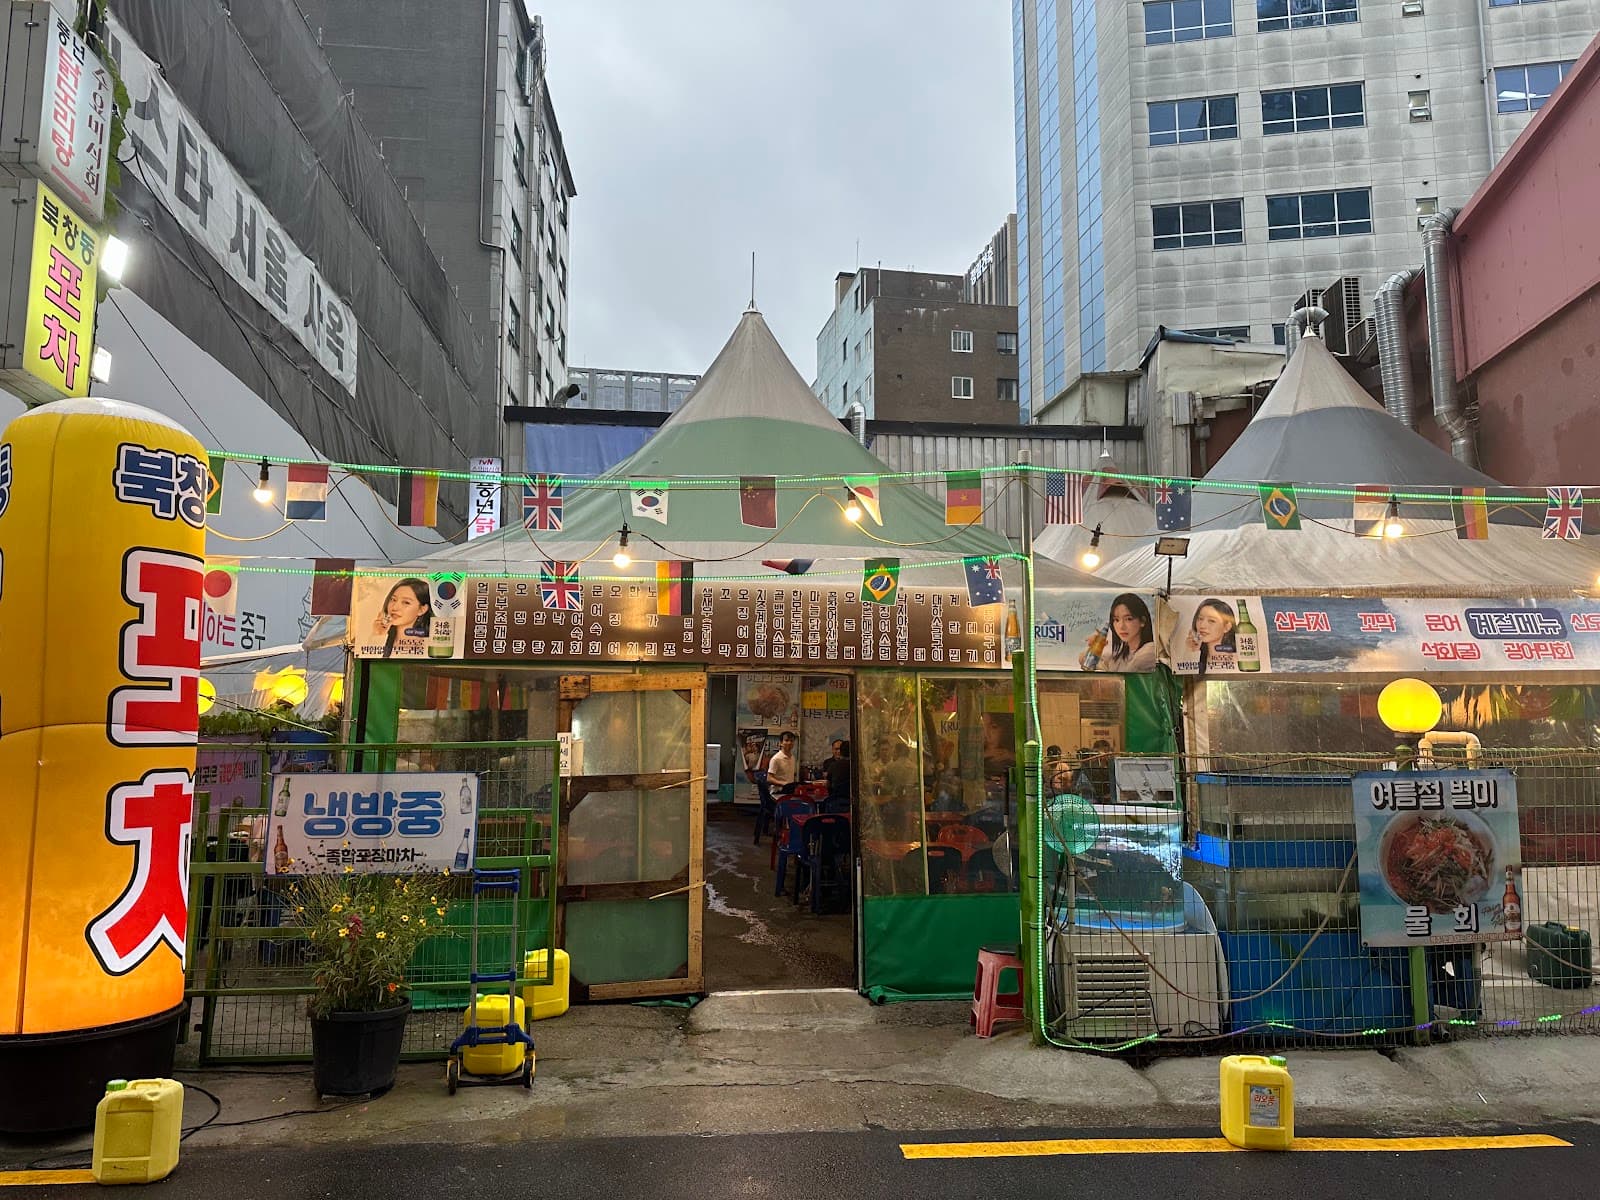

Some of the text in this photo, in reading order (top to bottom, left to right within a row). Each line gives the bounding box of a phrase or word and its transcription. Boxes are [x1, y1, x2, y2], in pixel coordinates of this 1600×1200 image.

[41, 195, 95, 266] 북창동
[230, 189, 288, 315] 서울
[304, 271, 346, 370] 사옥
[40, 245, 83, 391] 포차
[493, 582, 509, 654] 두부조개탕
[512, 583, 528, 654] 오뎅탕
[588, 585, 603, 655] 문어숙회
[607, 585, 622, 656] 오징어
[718, 587, 732, 658] 꼬막
[736, 588, 749, 658] 오징어회
[772, 589, 785, 659] 골뱅이소면
[878, 605, 892, 661] 징어소면
[913, 592, 927, 662] 먹태
[948, 594, 961, 662] 계란찜
[1034, 624, 1066, 643] RUSH
[1274, 611, 1332, 632] 산낙지
[1357, 612, 1397, 632] 꼬막
[1424, 614, 1462, 632] 문어
[1469, 612, 1563, 635] 계절메뉴
[1421, 642, 1576, 661] 석화(굴) 광어막회
[303, 790, 445, 838] 냉방중
[1370, 778, 1499, 811] 여름철 별미
[1404, 903, 1432, 936] 물
[1453, 903, 1480, 933] 회
